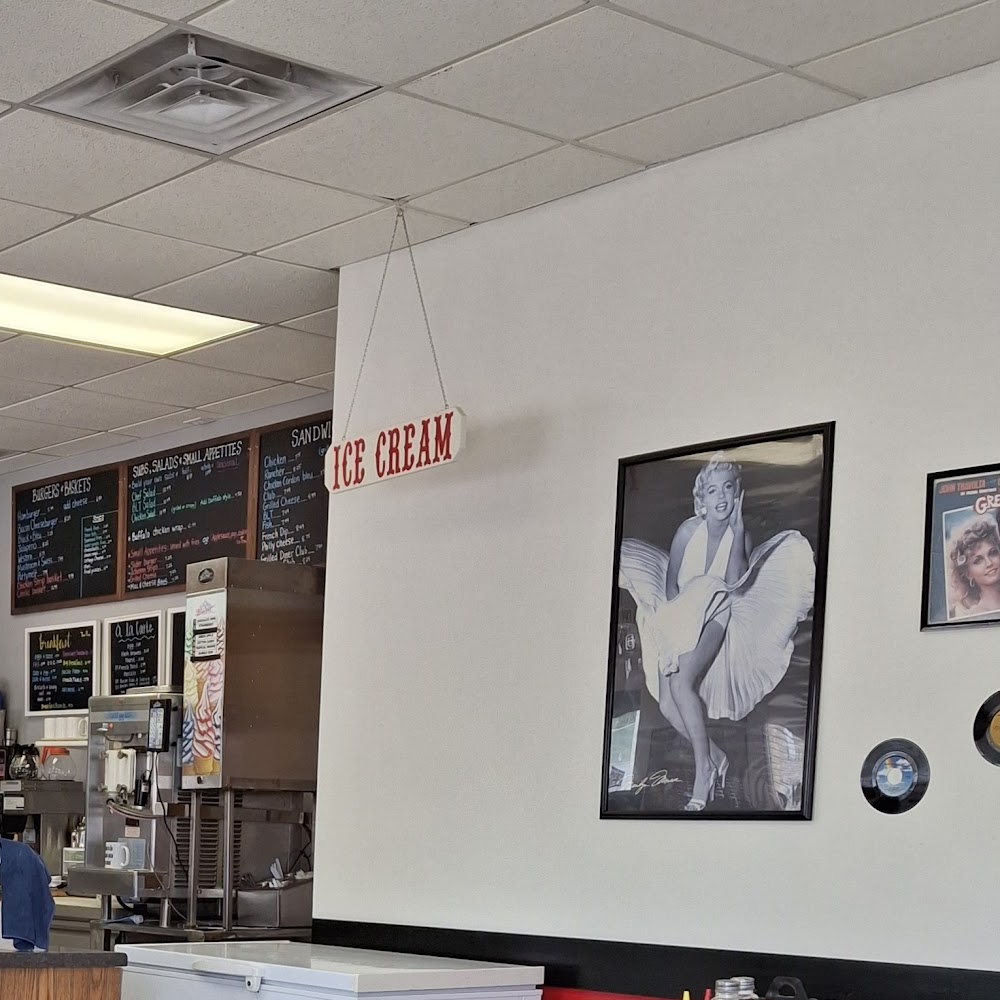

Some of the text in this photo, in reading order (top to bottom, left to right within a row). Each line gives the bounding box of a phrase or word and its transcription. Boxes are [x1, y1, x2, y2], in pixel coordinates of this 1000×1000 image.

[333, 411, 454, 490] ICE CREAM
[152, 455, 179, 473] SALADS
[183, 450, 202, 466] SMALL
[264, 454, 287, 468] Chicken
[283, 474, 300, 486] Cordon
[32, 483, 60, 502] BURGERS
[64, 476, 92, 496] BASKETS
[143, 485, 156, 499] Salad
[72, 498, 88, 508] cheese
[280, 496, 300, 507] Cheese
[131, 528, 151, 542] Buffalo
[153, 526, 170, 537] chicken
